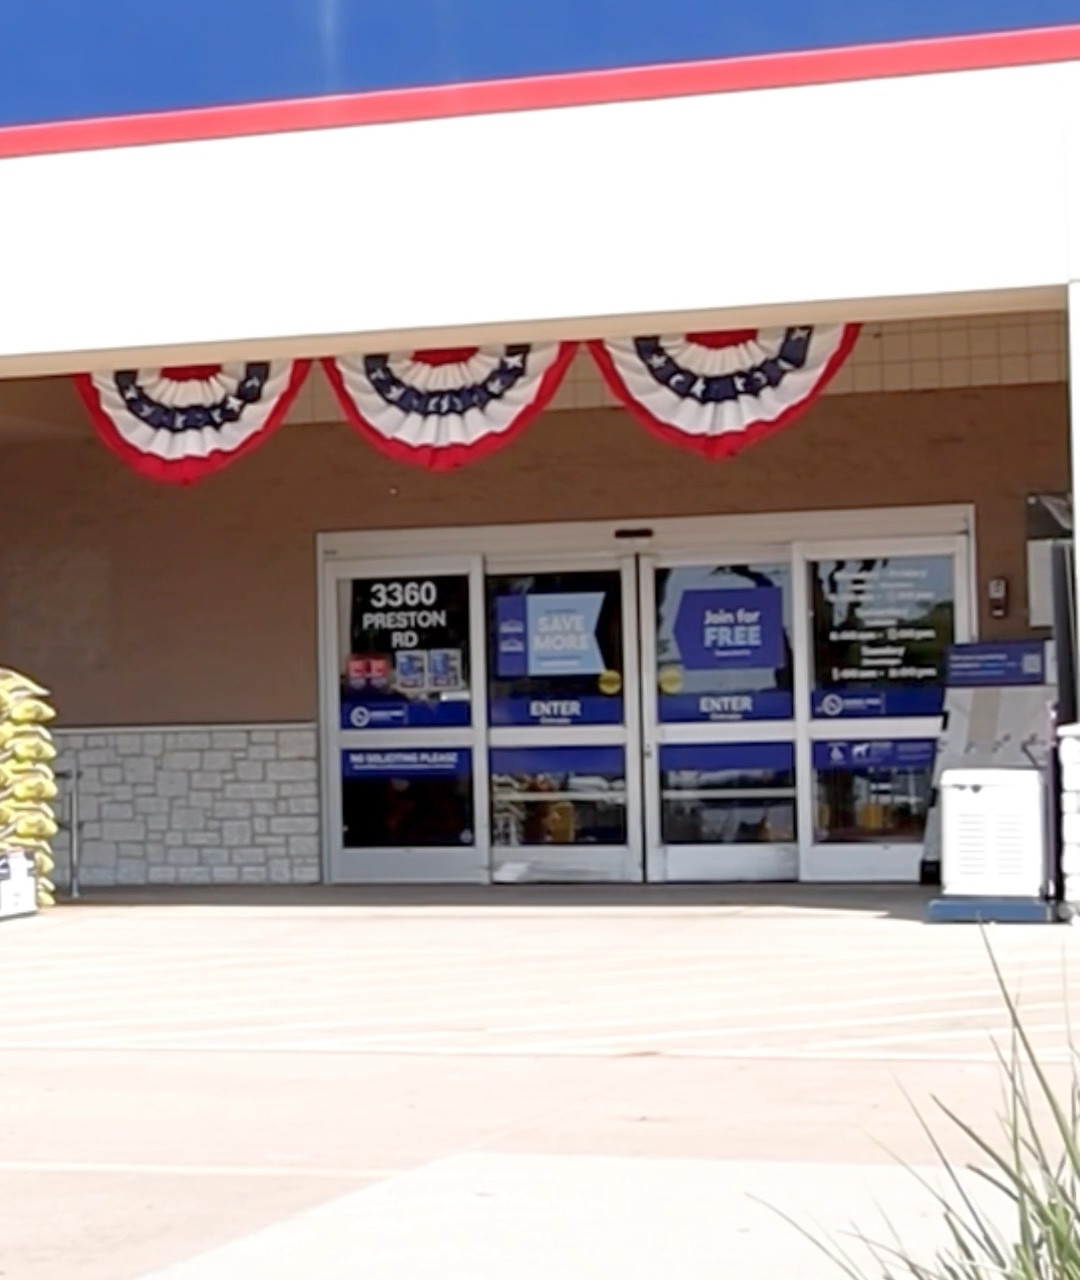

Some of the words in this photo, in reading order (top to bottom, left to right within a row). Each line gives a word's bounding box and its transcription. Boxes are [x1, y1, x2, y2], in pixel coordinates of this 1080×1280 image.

[370, 581, 437, 608] 3360
[362, 610, 447, 631] PRESTON
[537, 614, 585, 633] SAVE
[391, 631, 419, 649] RD
[532, 633, 590, 652] MORE
[703, 624, 762, 648] FREE
[529, 700, 582, 718] ENTER
[699, 695, 754, 714] ENTER
